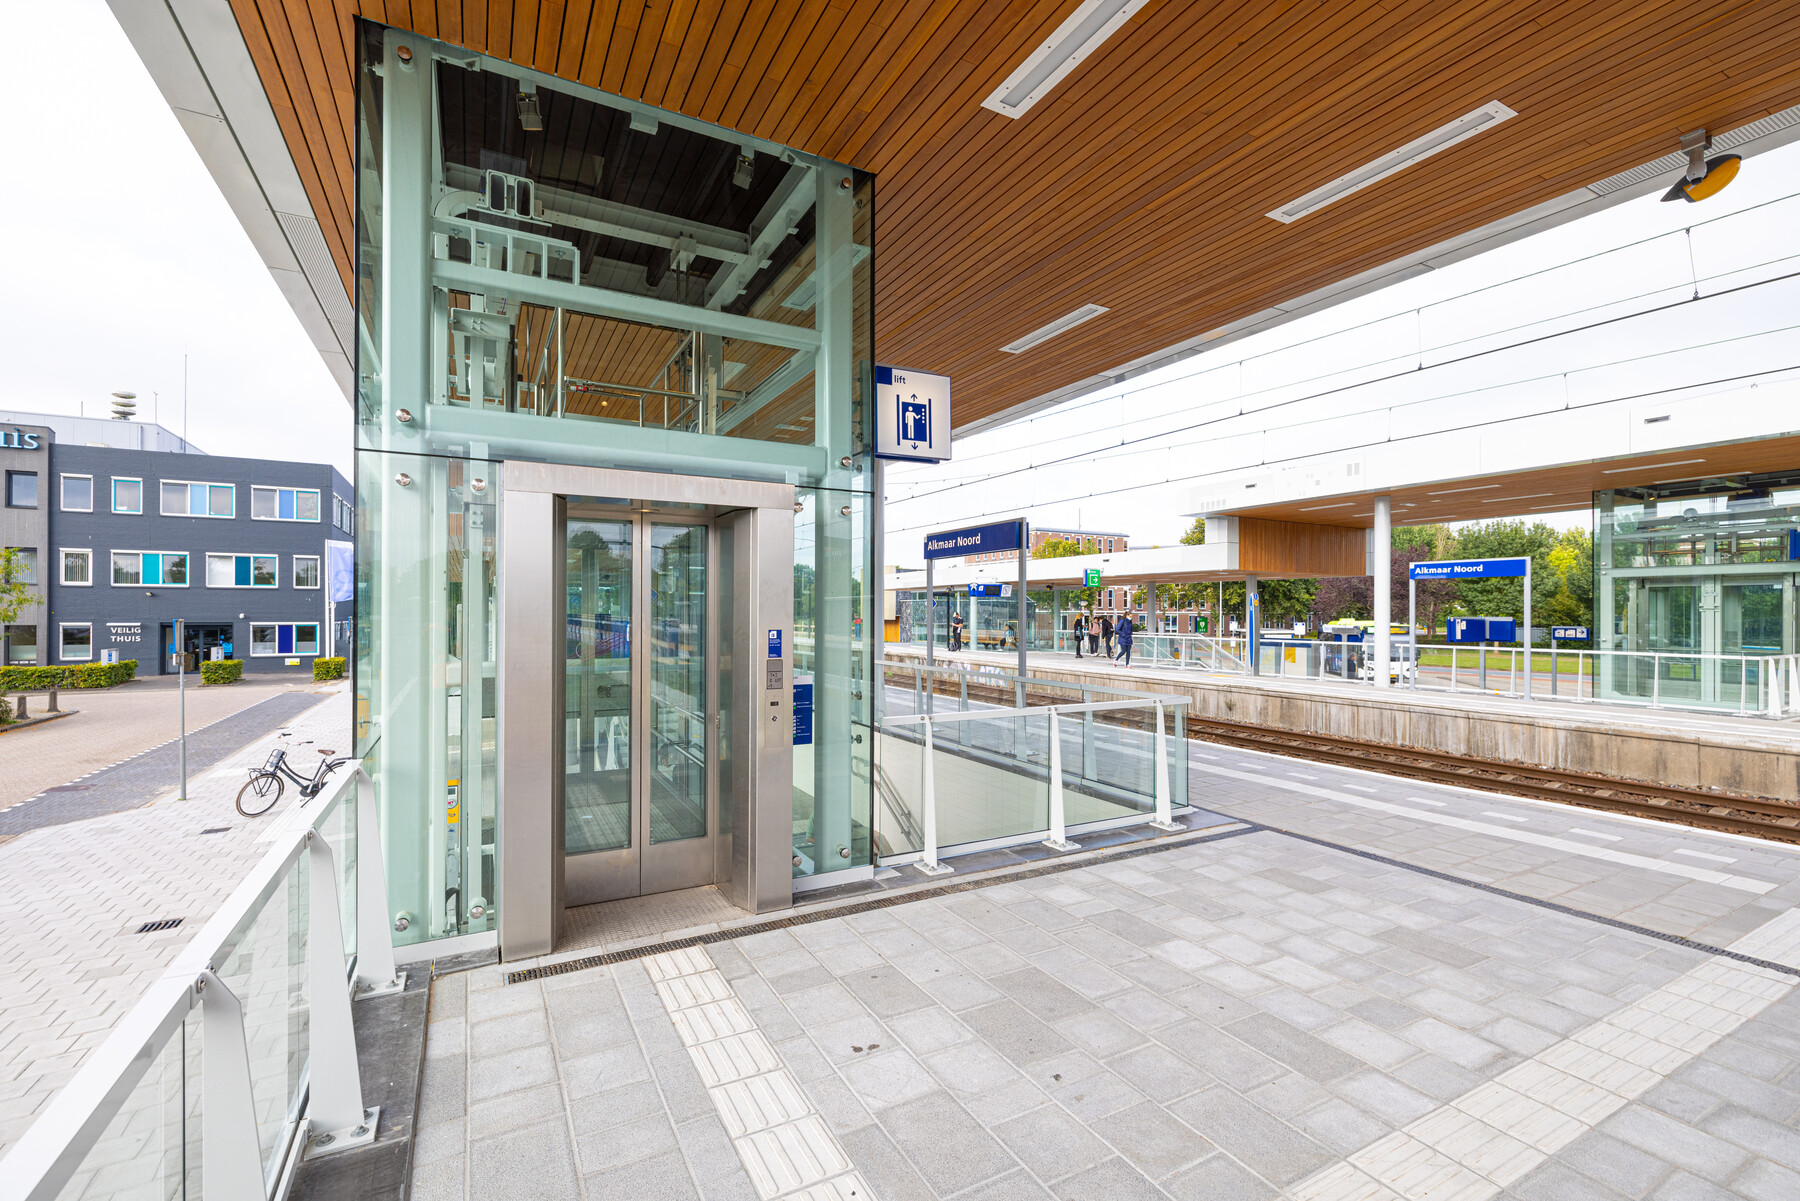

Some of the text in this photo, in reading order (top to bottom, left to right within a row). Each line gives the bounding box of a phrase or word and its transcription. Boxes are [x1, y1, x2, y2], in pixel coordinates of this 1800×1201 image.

[894, 375, 906, 384] lift
[927, 533, 981, 551] Alkmaar Noord
[1414, 567, 1452, 575] Alkmaar
[1453, 564, 1484, 573] Noord
